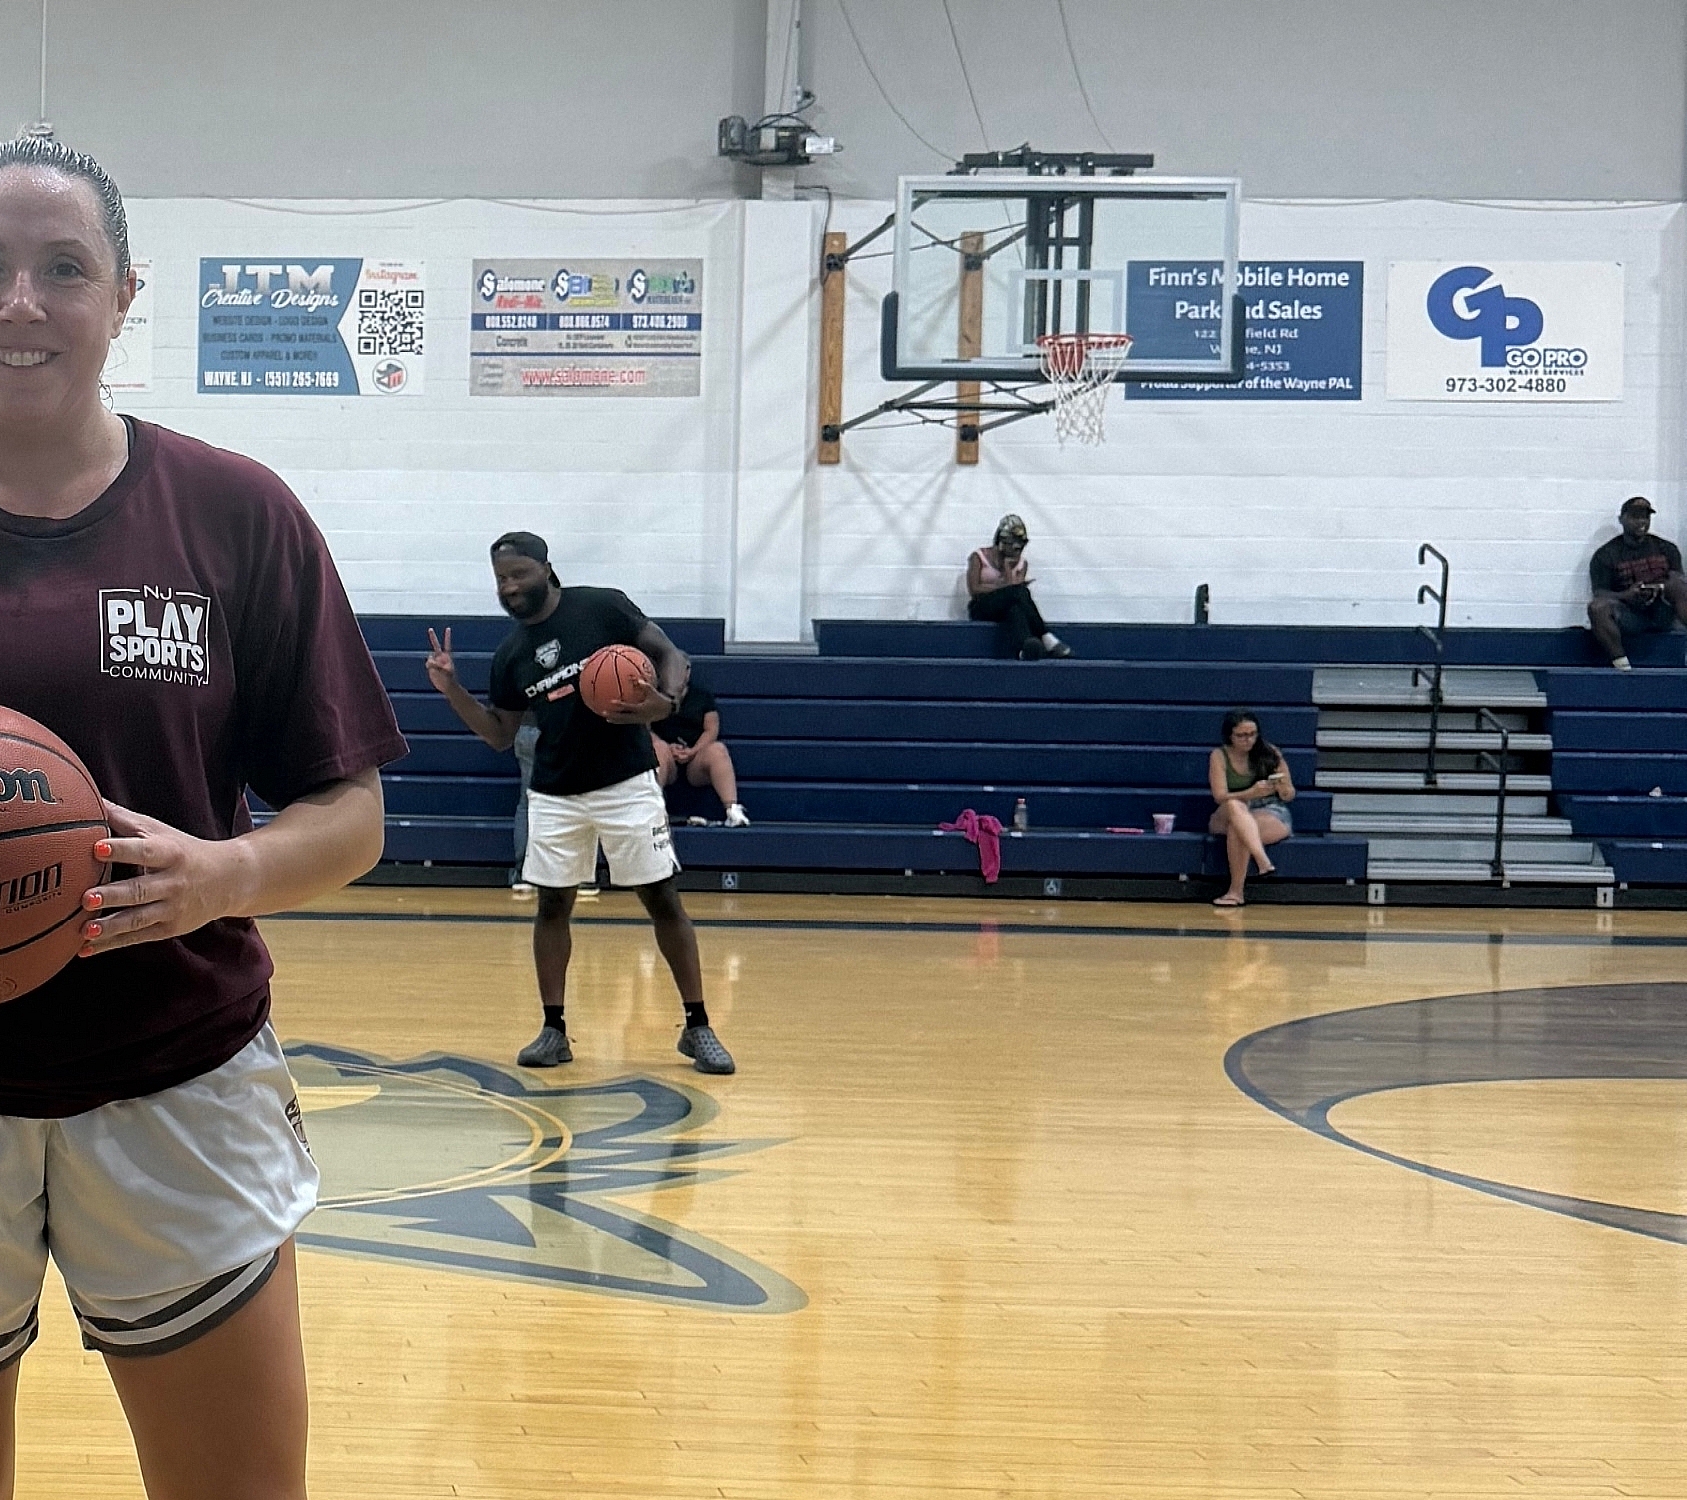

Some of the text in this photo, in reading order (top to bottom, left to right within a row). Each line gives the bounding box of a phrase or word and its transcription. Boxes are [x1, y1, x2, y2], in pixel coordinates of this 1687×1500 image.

[1149, 267, 1207, 287] Finn's
[1287, 268, 1350, 287] Home
[201, 287, 339, 312] Creative Designs
[1268, 299, 1323, 320] Sales
[1280, 328, 1299, 338] Rd
[1505, 348, 1588, 368] GO PRO
[1245, 376, 1262, 389] of
[1262, 377, 1281, 389] the
[1283, 377, 1326, 392] Wayne
[1328, 377, 1353, 389] PAL
[1446, 378, 1566, 393] 973-302-4880
[143, 584, 173, 600] NJ
[107, 599, 204, 643] PLAY
[109, 634, 204, 672] SPORTS
[109, 665, 204, 687] COMMUNITY
